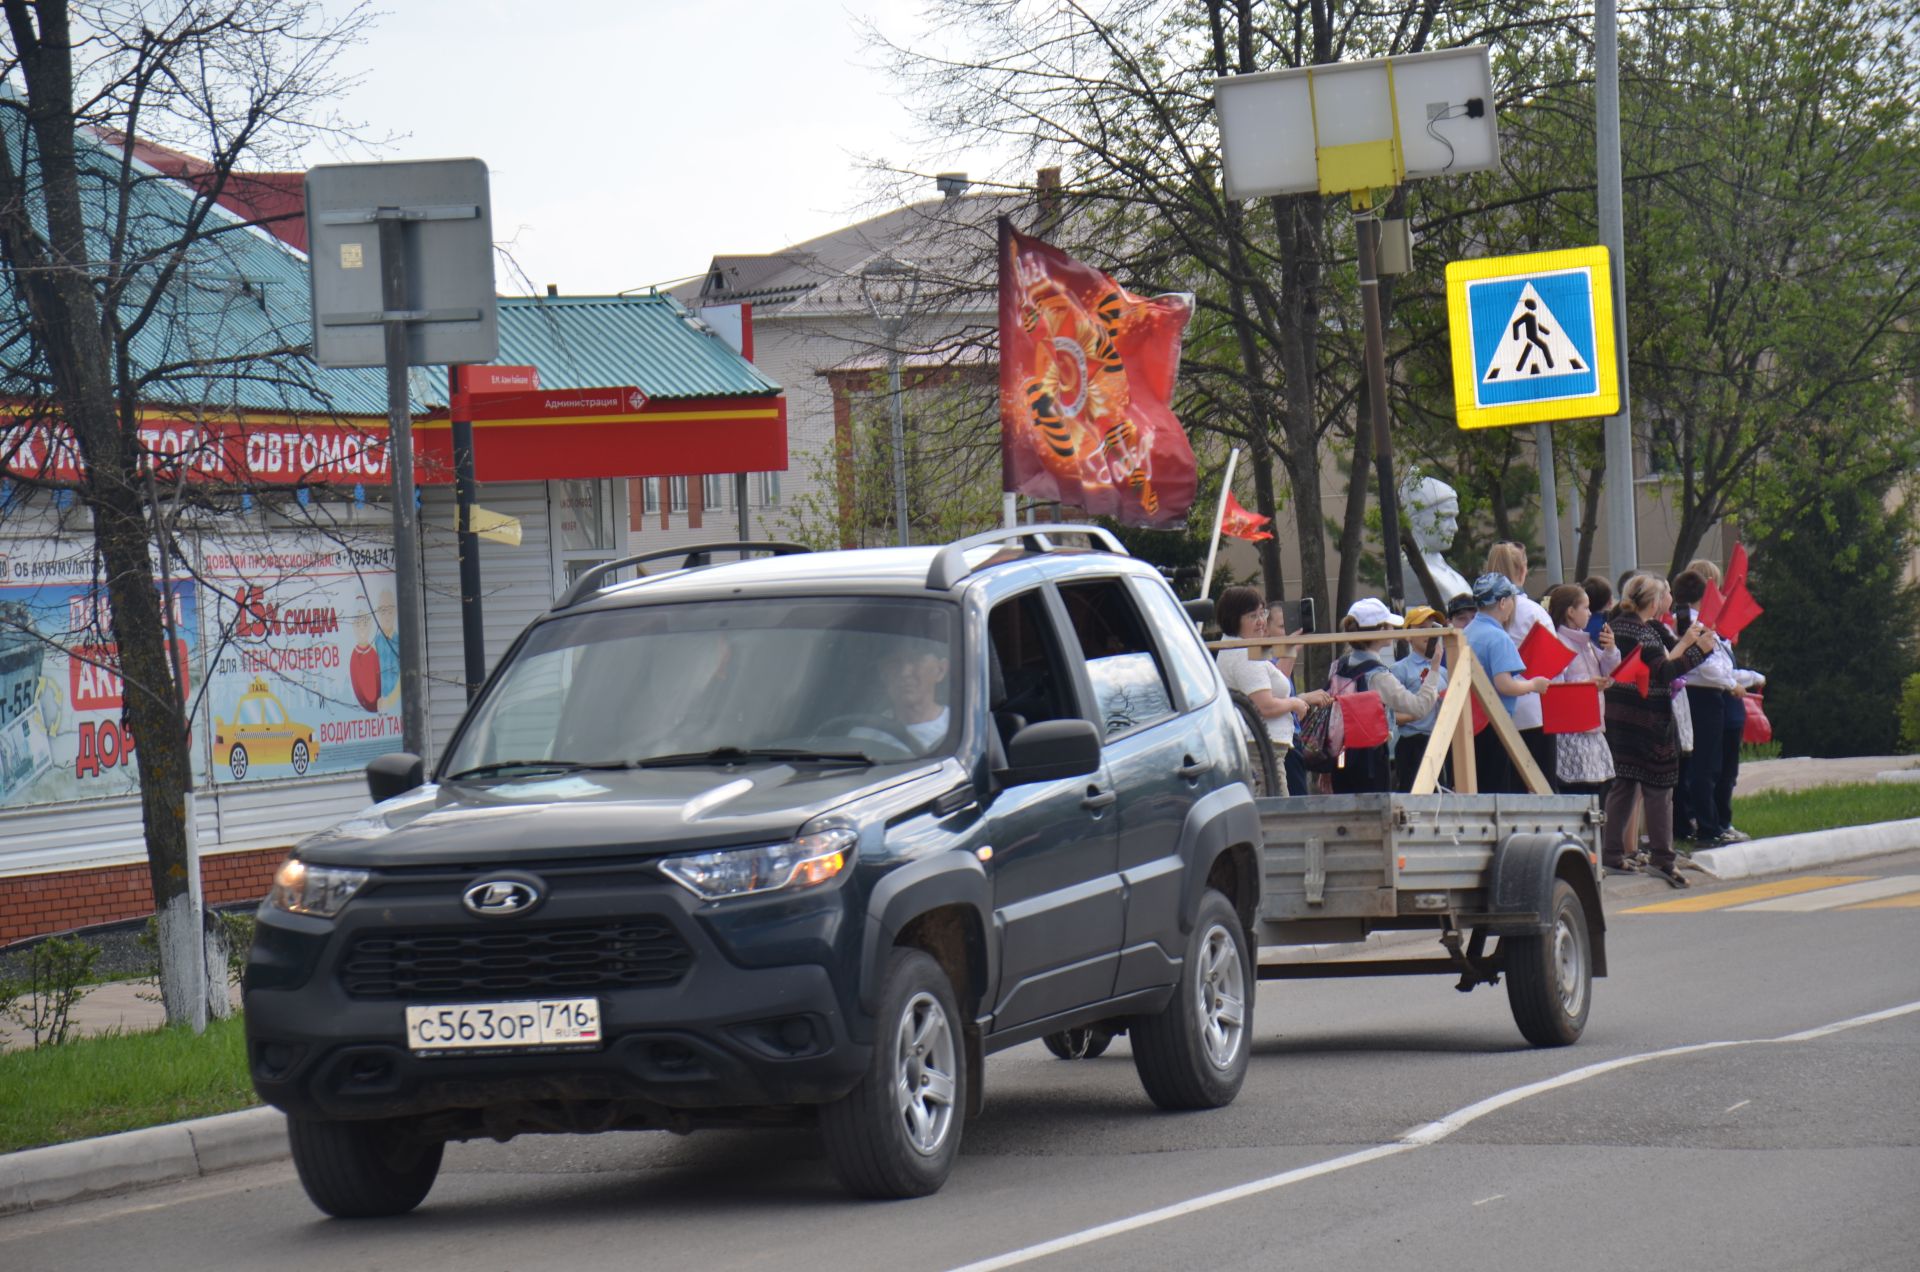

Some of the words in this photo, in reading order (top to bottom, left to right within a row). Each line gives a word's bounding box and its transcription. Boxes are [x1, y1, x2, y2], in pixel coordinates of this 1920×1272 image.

[545, 399, 618, 409] Администрация
[247, 431, 414, 474] автомасл
[15, 562, 28, 577] ОБ
[206, 553, 246, 570] ДОВЕРЯЙ
[249, 552, 335, 569] ПРОФЕССИОНАЛАМ!
[234, 586, 281, 637] 15%
[284, 607, 338, 638] СКИДКА
[219, 658, 237, 675] ДЛЯ
[242, 645, 340, 673] ПЕНСИОНЕРОВ
[320, 717, 384, 744] ВОДИТЕЛЕЙ
[418, 1010, 535, 1042] С563ОР
[542, 1003, 589, 1029] 716
[555, 1027, 580, 1038] RUS
